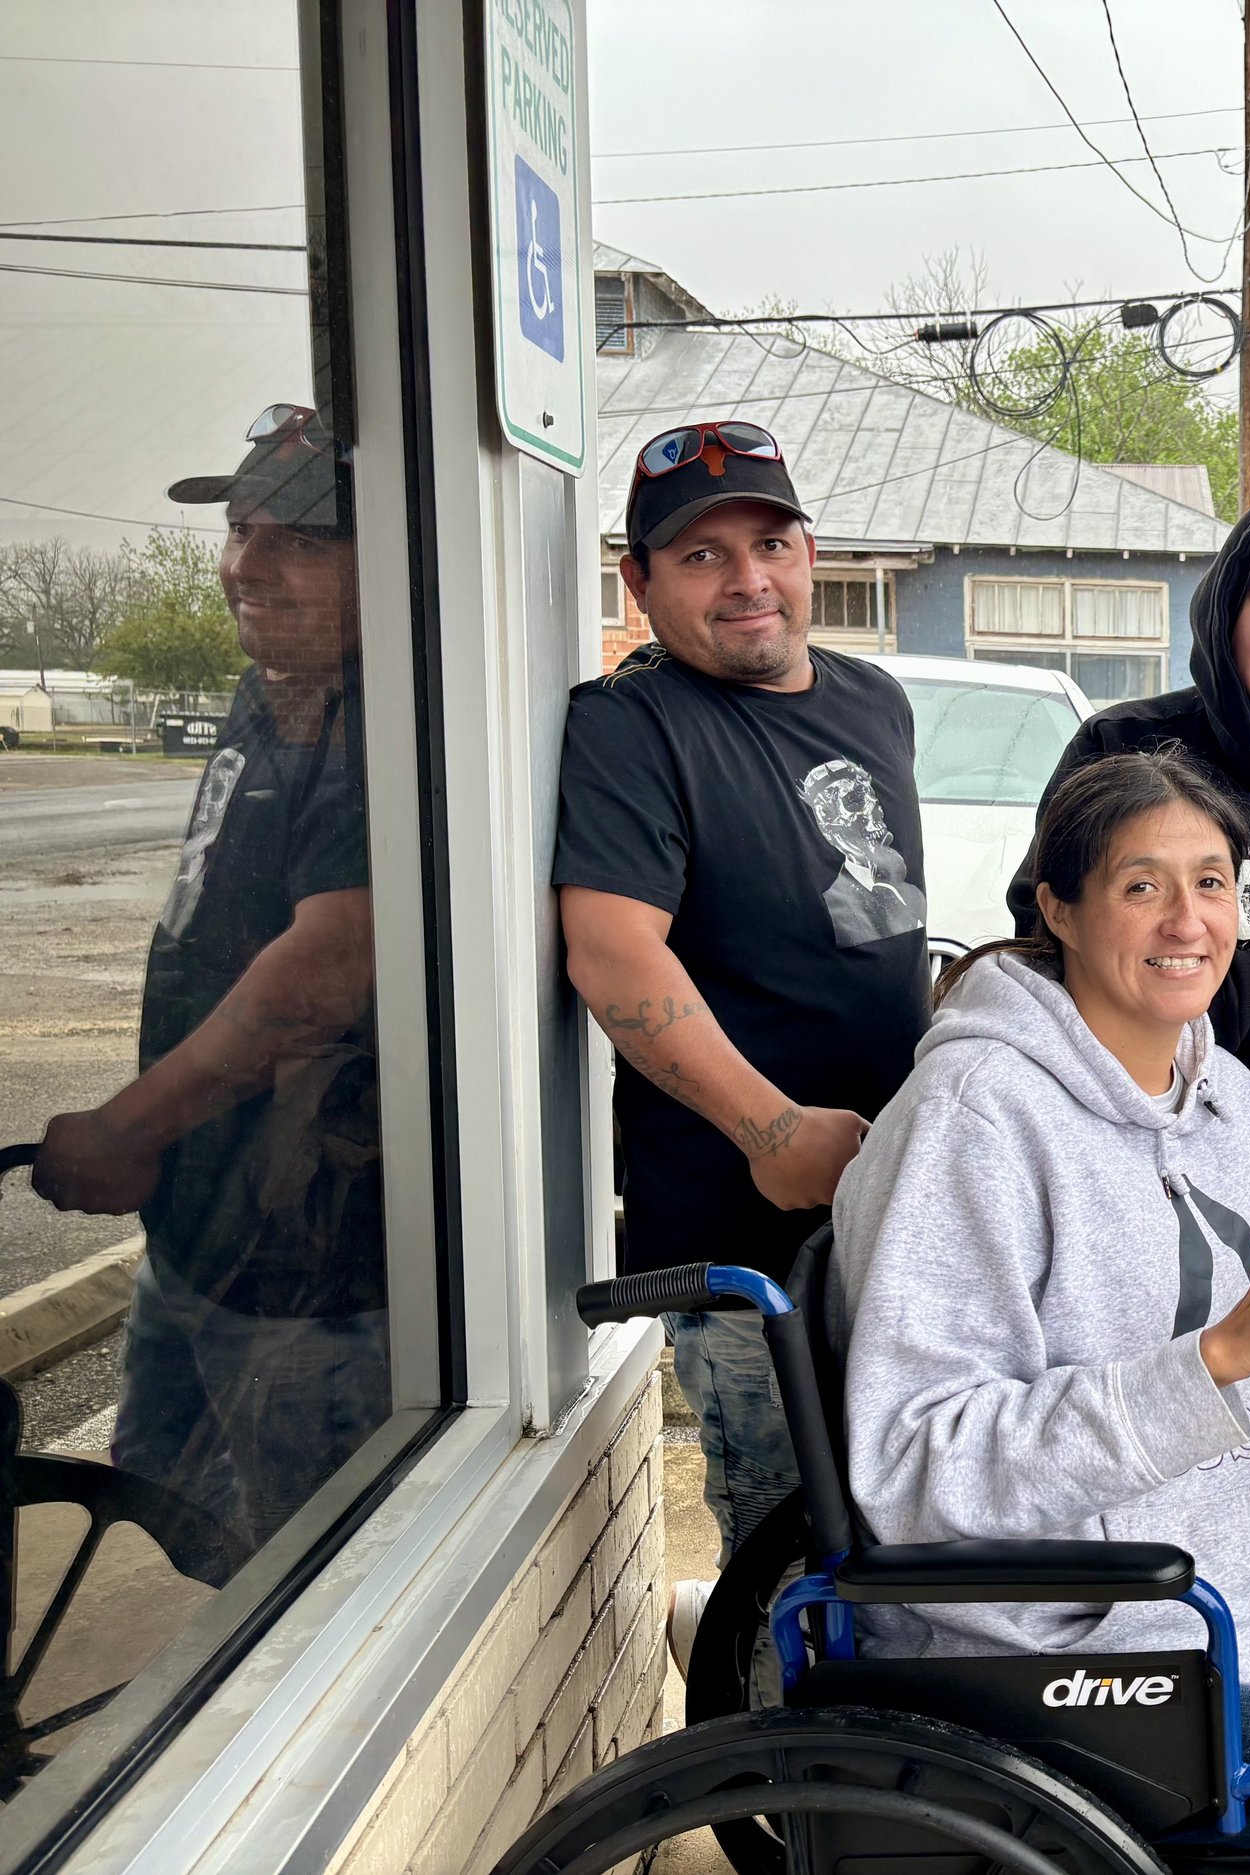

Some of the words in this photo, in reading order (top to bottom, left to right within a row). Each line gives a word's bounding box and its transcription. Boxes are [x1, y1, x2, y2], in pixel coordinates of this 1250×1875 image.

[496, 0, 570, 95] SERVED
[502, 43, 567, 176] PARKING
[1043, 1670, 1174, 1707] drive
